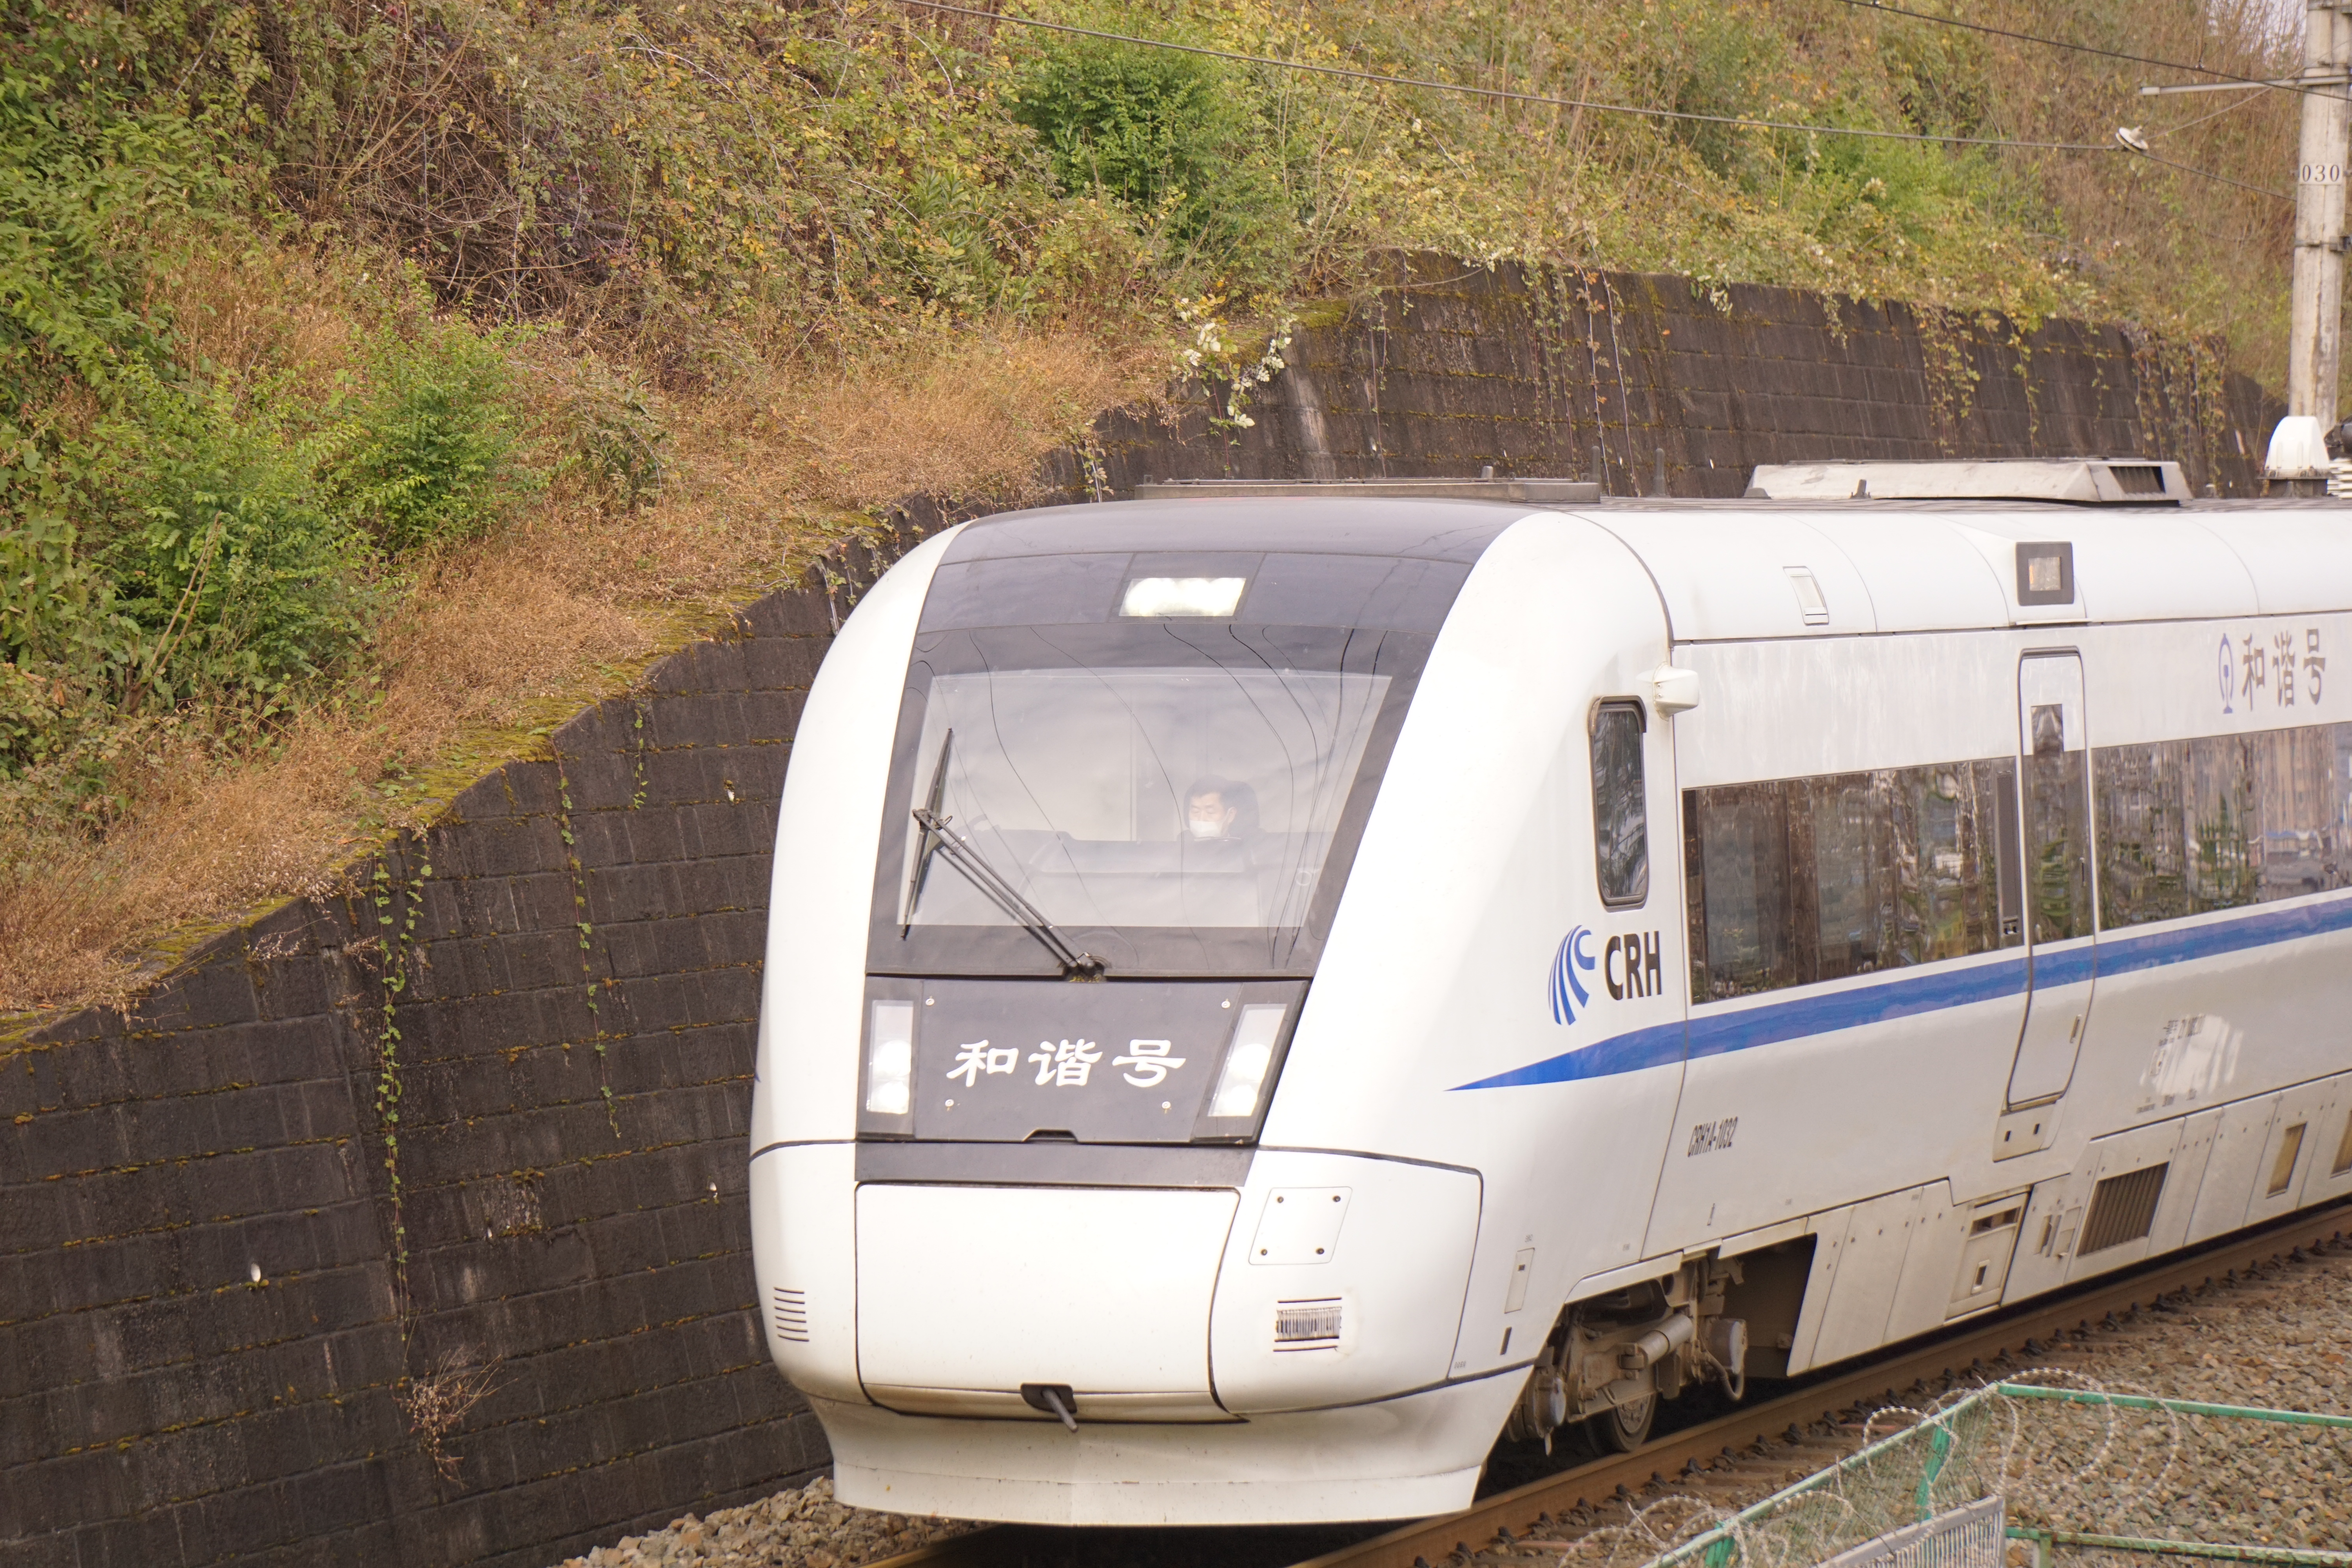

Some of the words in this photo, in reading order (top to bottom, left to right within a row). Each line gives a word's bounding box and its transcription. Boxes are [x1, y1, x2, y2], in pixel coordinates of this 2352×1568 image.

[2302, 165, 2339, 182] 030
[2241, 628, 2326, 712] 和谐号
[1604, 931, 1662, 1000] CRH
[946, 1038, 1186, 1087] 和谐号
[1688, 1116, 1738, 1157] CRH1A-1032
